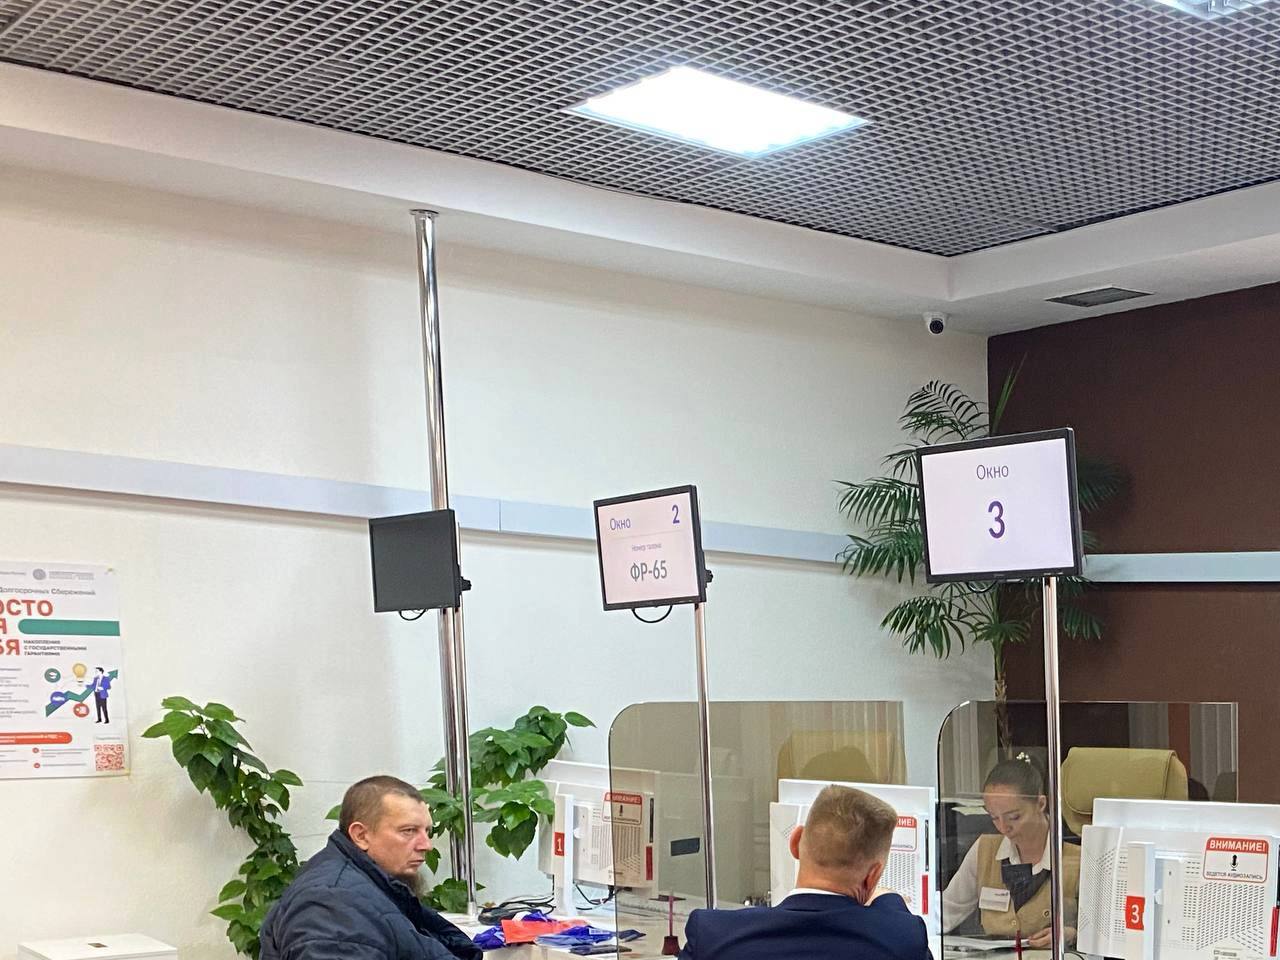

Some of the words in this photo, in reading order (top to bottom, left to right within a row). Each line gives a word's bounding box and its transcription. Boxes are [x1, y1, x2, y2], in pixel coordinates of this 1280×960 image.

[976, 464, 1009, 480] Окно
[609, 517, 631, 531] Окно
[671, 504, 680, 524] 2
[987, 500, 1006, 539] 3
[630, 560, 668, 582] ФР-65
[0, 598, 54, 616] СТО
[557, 837, 562, 852] 1
[1209, 839, 1266, 852] ВНИМАНИЕ!
[1131, 904, 1140, 924] 3
